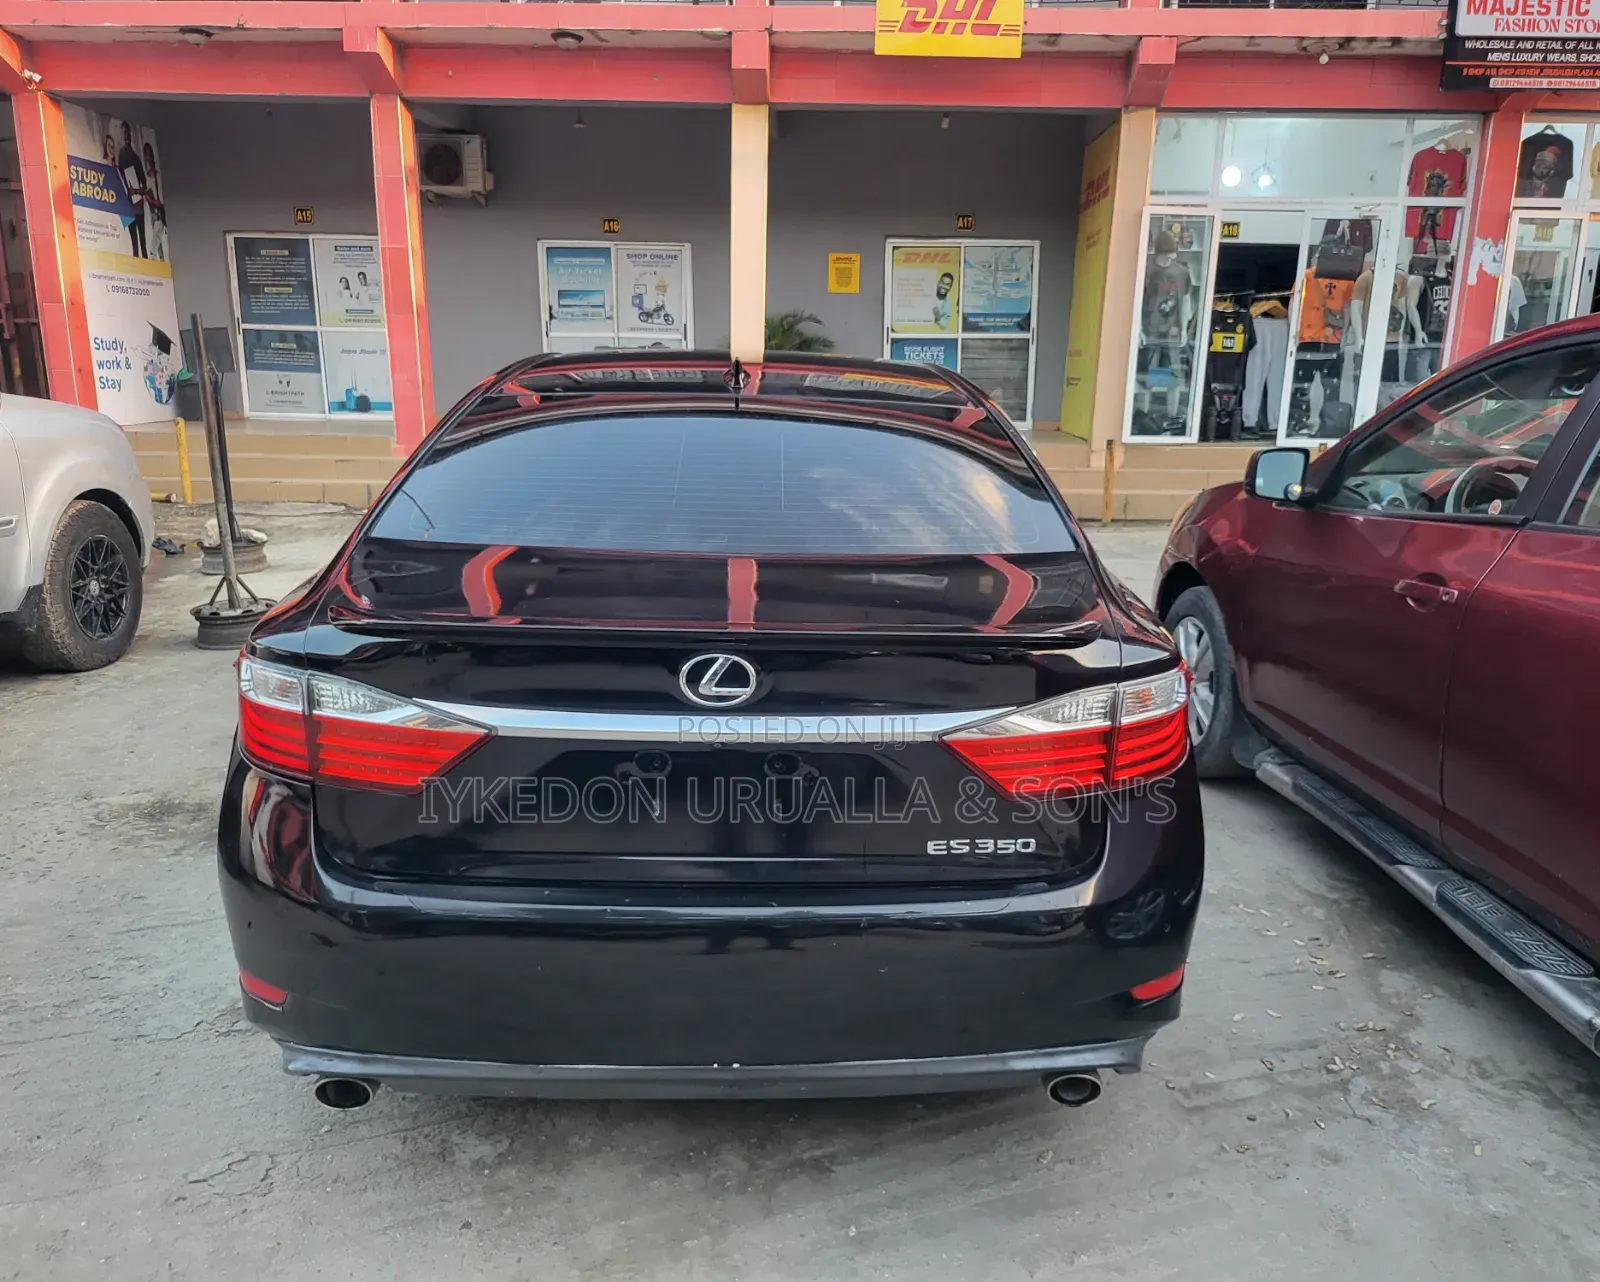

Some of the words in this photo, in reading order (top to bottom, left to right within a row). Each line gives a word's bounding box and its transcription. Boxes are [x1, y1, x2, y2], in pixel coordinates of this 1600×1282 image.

[1466, 0, 1592, 17] MAJESTIC
[898, 0, 1001, 36] DHL
[1494, 18, 1560, 33] FASHION
[1465, 40, 1515, 49] WHOLESALE
[1516, 40, 1535, 49] AND
[1535, 41, 1563, 50] RETAIL
[1565, 41, 1576, 50] OF
[1578, 41, 1594, 50] ALL
[1487, 52, 1511, 62] MENS
[1511, 53, 1545, 62] LUXURY
[1546, 53, 1578, 63] WEARS,
[70, 165, 105, 186] STUDY
[72, 181, 117, 203] ABROAD
[296, 210, 312, 222] A15
[957, 217, 973, 228] A17
[901, 252, 952, 263] DHL
[93, 336, 128, 355] Study,
[96, 356, 122, 370] work
[124, 356, 132, 370] &
[904, 352, 945, 360] TICKETS
[98, 375, 122, 392] Stay
[926, 838, 970, 856] ES
[974, 838, 1037, 854] 350
